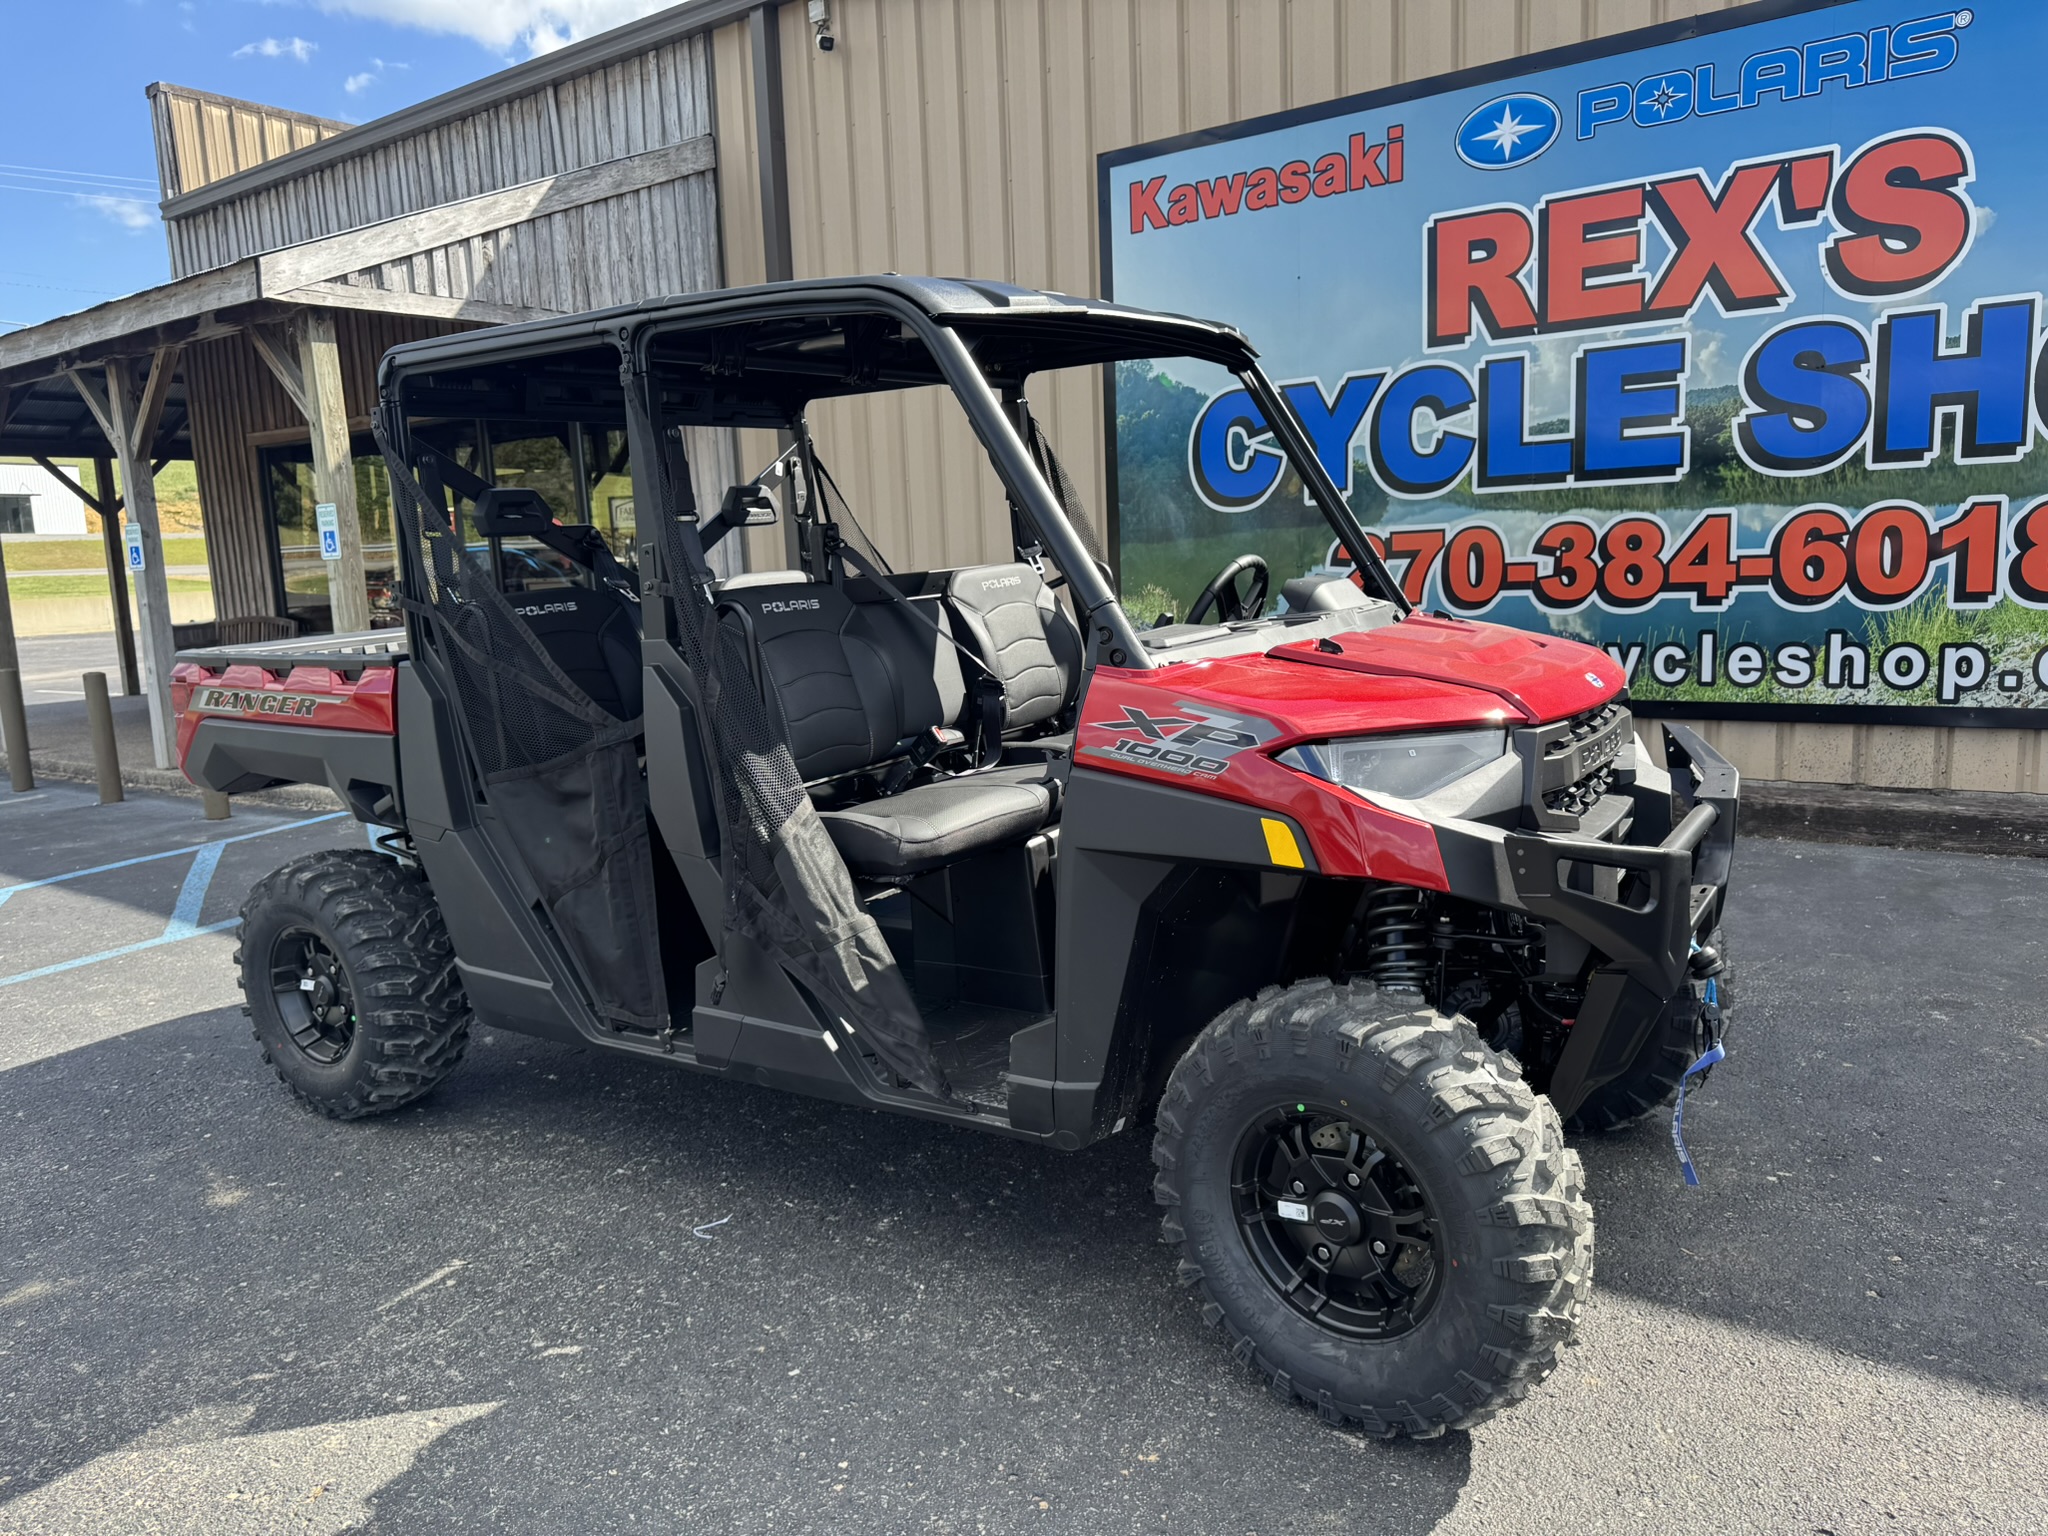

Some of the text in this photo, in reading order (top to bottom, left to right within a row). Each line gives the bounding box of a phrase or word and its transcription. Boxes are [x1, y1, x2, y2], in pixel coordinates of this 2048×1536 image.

[1129, 123, 1404, 235] Kawasaki
[1425, 130, 1972, 350] REX'S
[1192, 296, 2048, 508] CYCLE SH
[981, 576, 1021, 591] POLARIS
[514, 602, 577, 616] POLARIS
[761, 599, 820, 614] POLARIS
[1603, 629, 2048, 702] ycleshop.
[204, 689, 318, 717] RANGER
[1087, 705, 1261, 750] XP
[1110, 752, 1218, 780] DUAL OVERHEAD CAM
[1112, 738, 1230, 775] 1000
